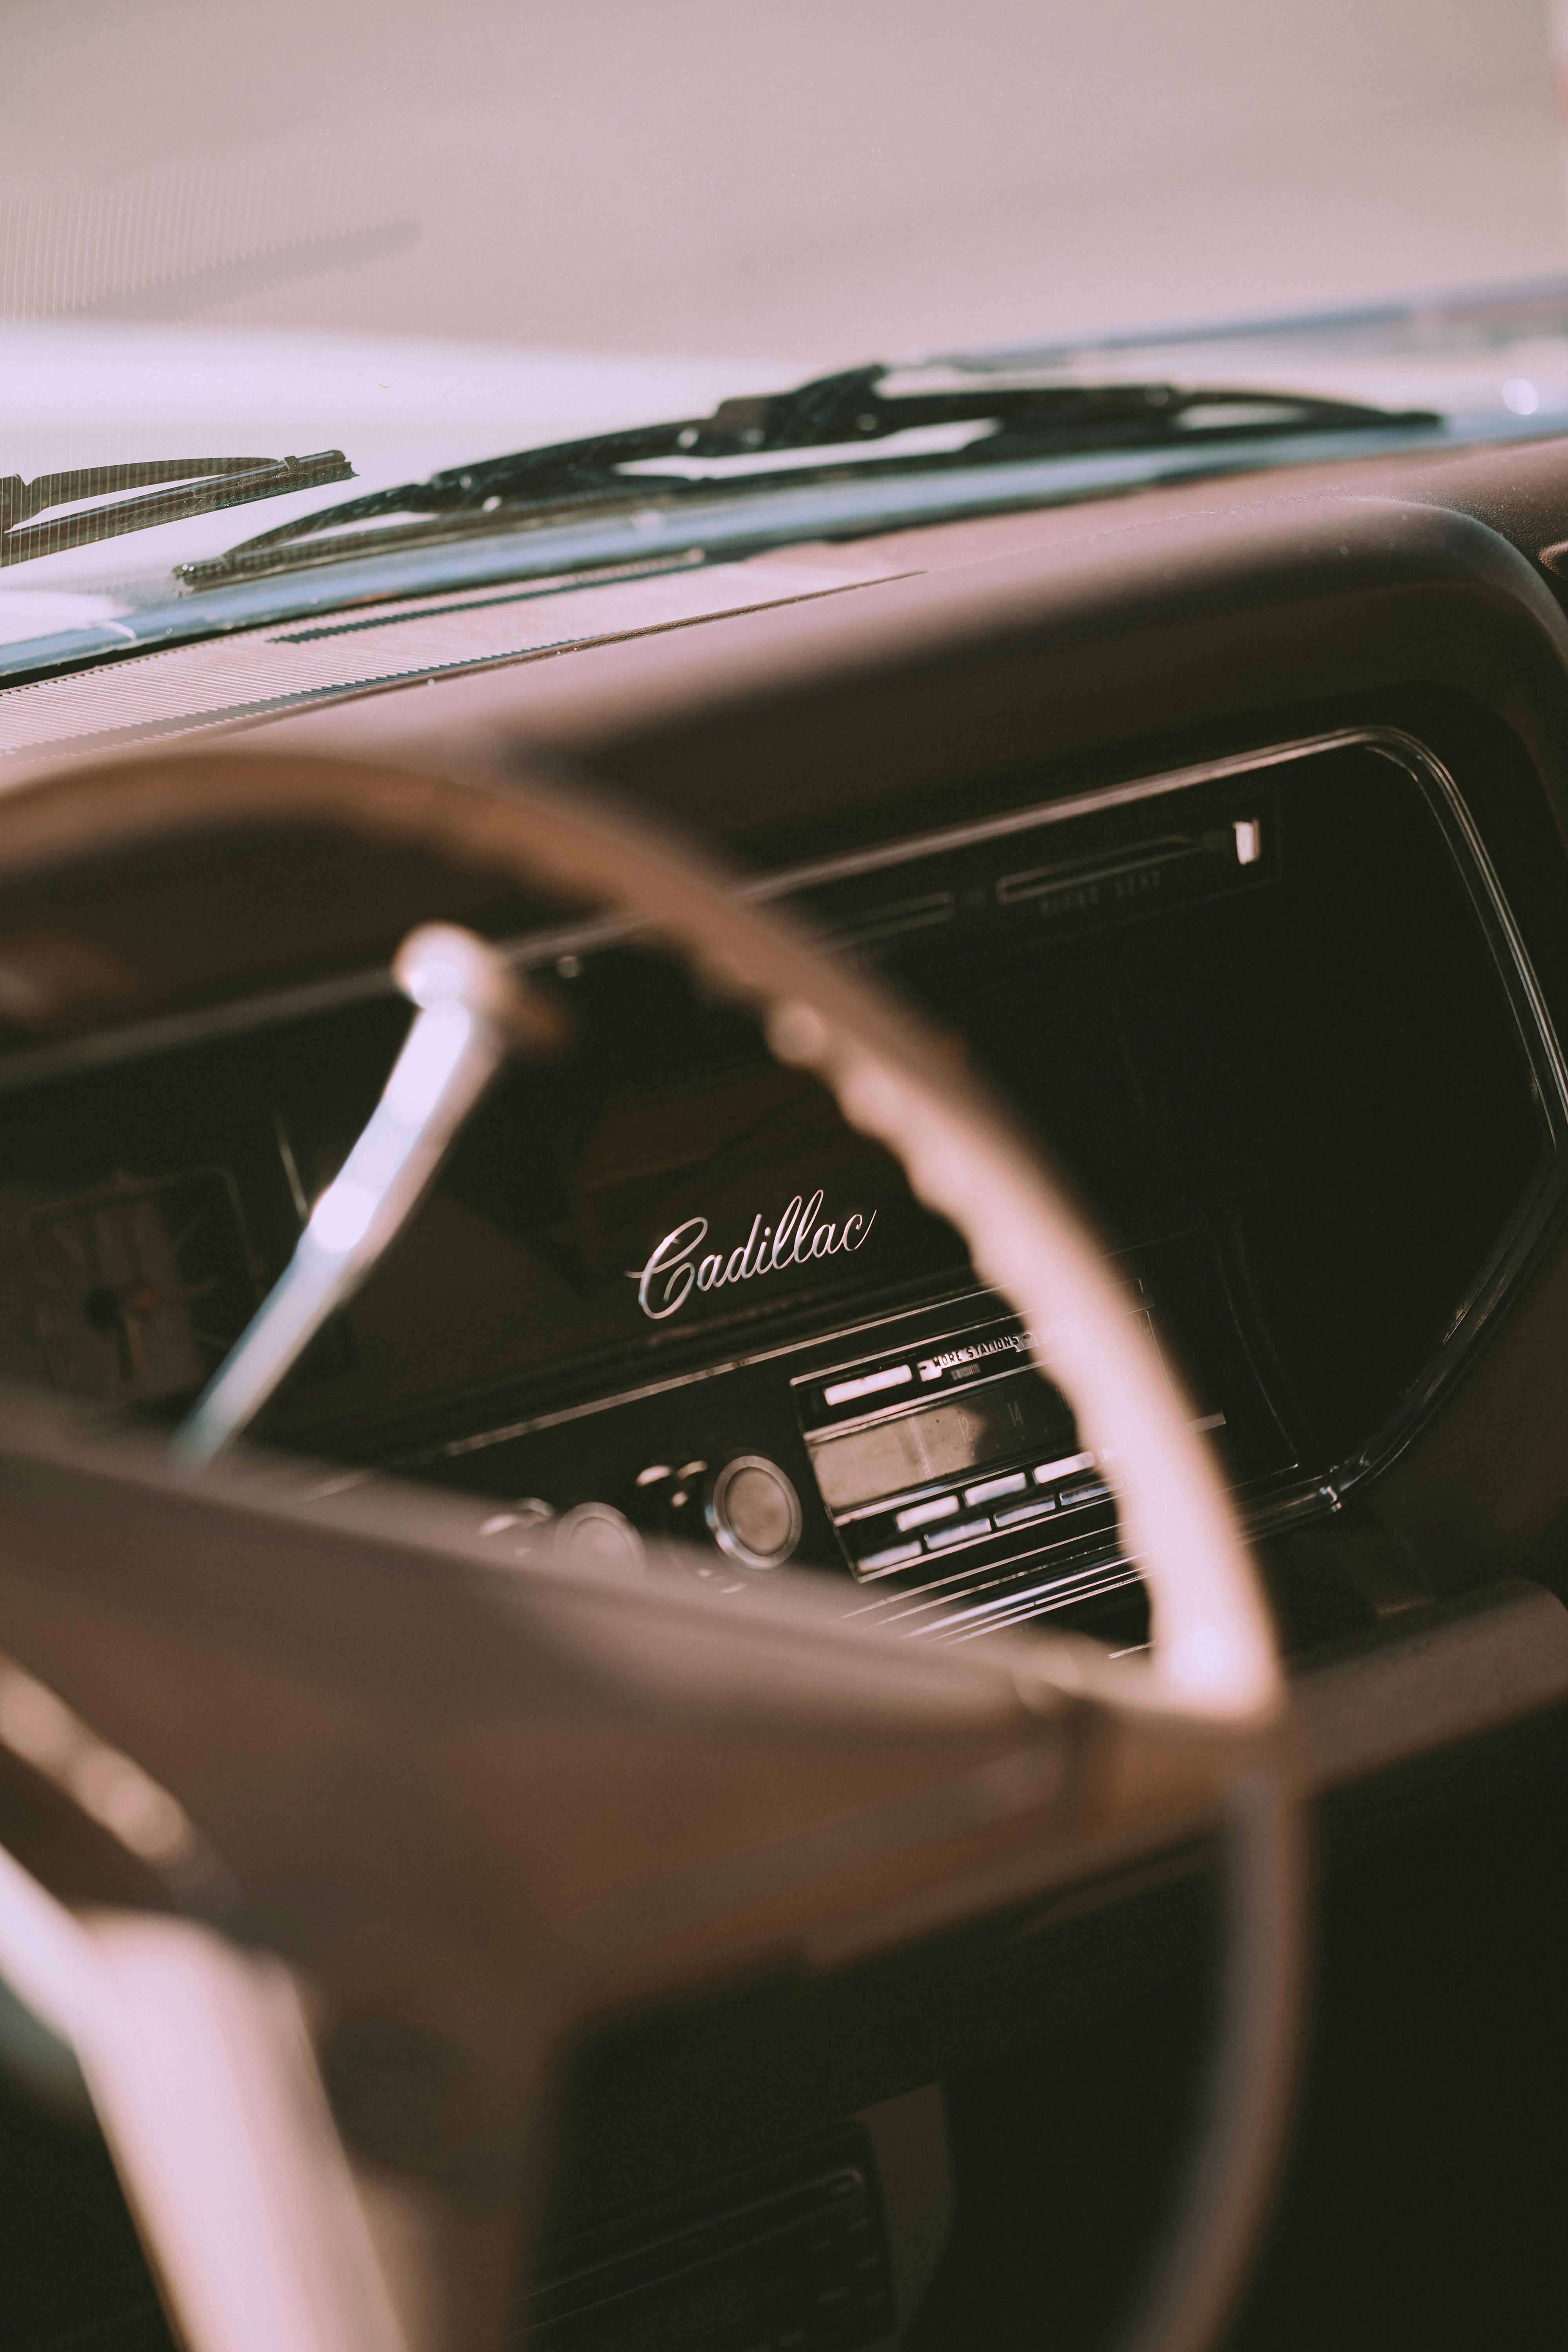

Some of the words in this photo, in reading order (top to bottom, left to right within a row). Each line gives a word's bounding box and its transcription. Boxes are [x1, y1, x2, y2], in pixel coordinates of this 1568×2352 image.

[625, 1189, 877, 1319] Cadillac
[933, 1350, 962, 1367] MORE
[966, 1334, 1019, 1357] STATIONS
[956, 1417, 974, 1443] 12
[1006, 1401, 1024, 1428] 14
